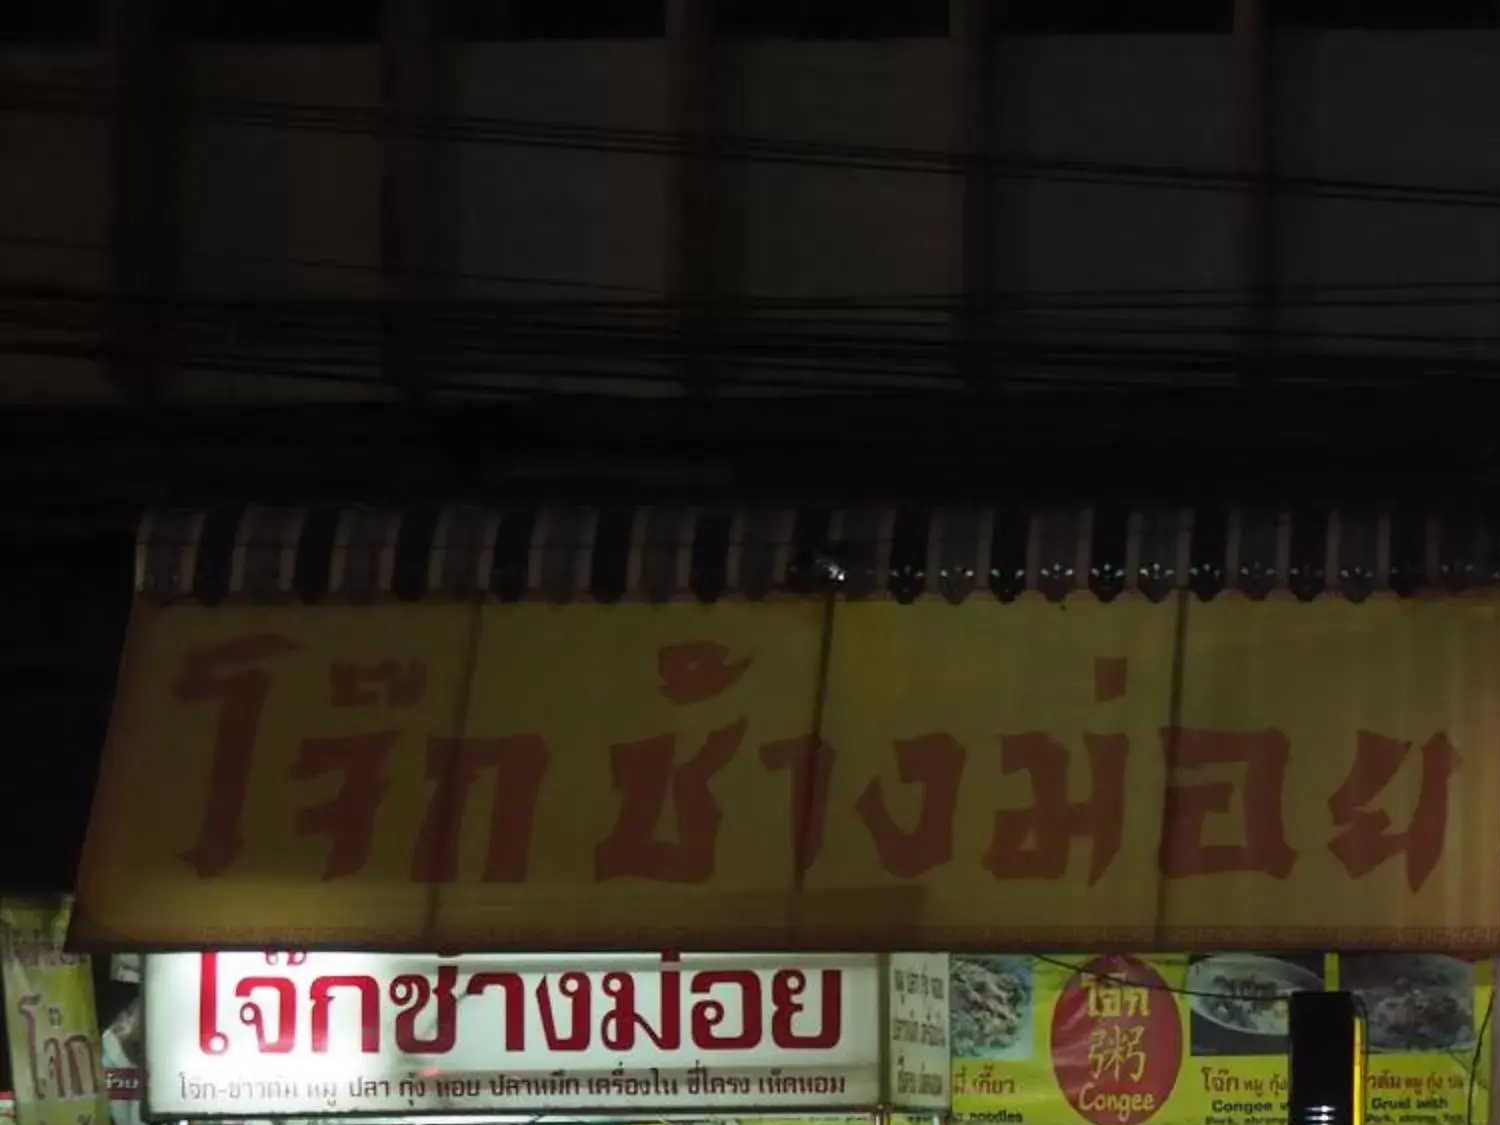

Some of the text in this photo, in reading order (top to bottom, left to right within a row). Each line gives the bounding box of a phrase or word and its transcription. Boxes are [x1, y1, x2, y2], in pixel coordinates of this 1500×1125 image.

[198, 949, 842, 1056] โจ๊กชางม่อย
[1088, 1023, 1148, 1083] 粥
[1078, 1081, 1156, 1123] Congee
